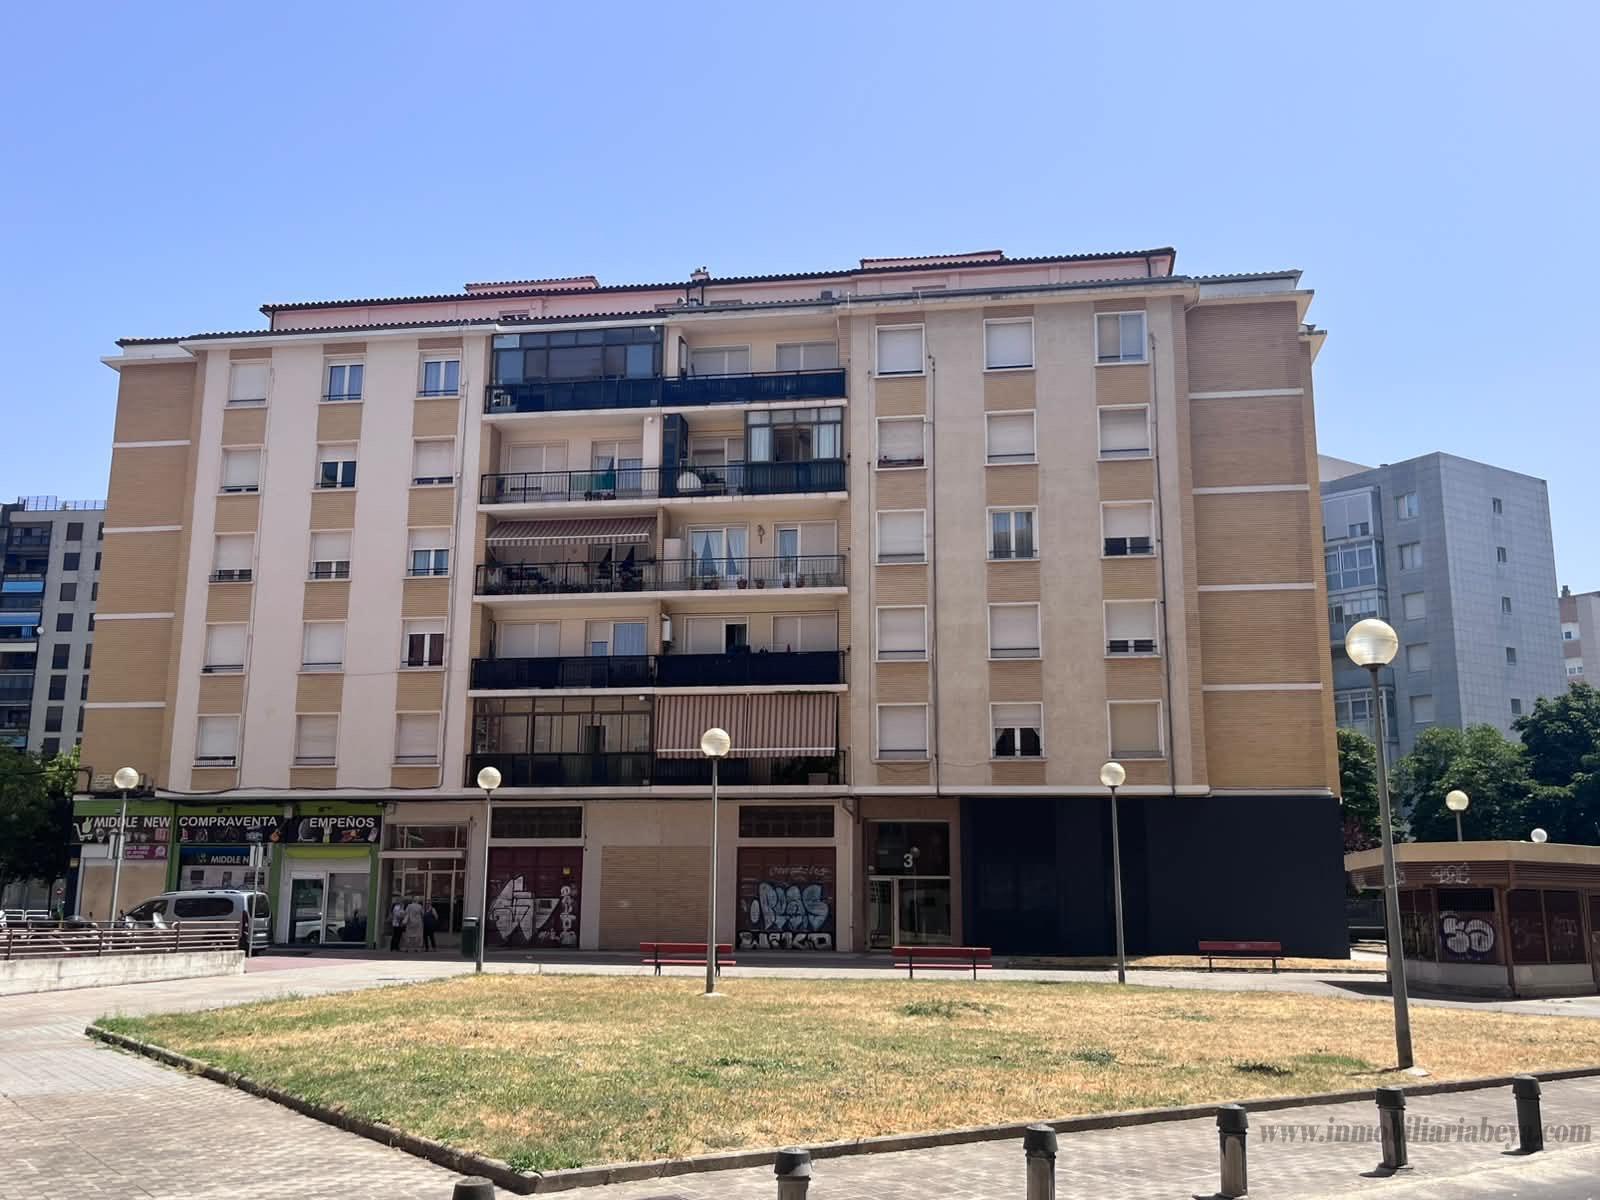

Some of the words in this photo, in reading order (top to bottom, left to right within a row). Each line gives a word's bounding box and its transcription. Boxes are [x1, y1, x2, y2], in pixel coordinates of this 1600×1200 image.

[143, 816, 171, 828] NEW
[179, 816, 278, 827] COMPRAVENTA
[309, 815, 375, 828] EMPEÑOS
[210, 855, 241, 864] MIDDLE
[903, 853, 913, 868] 3
